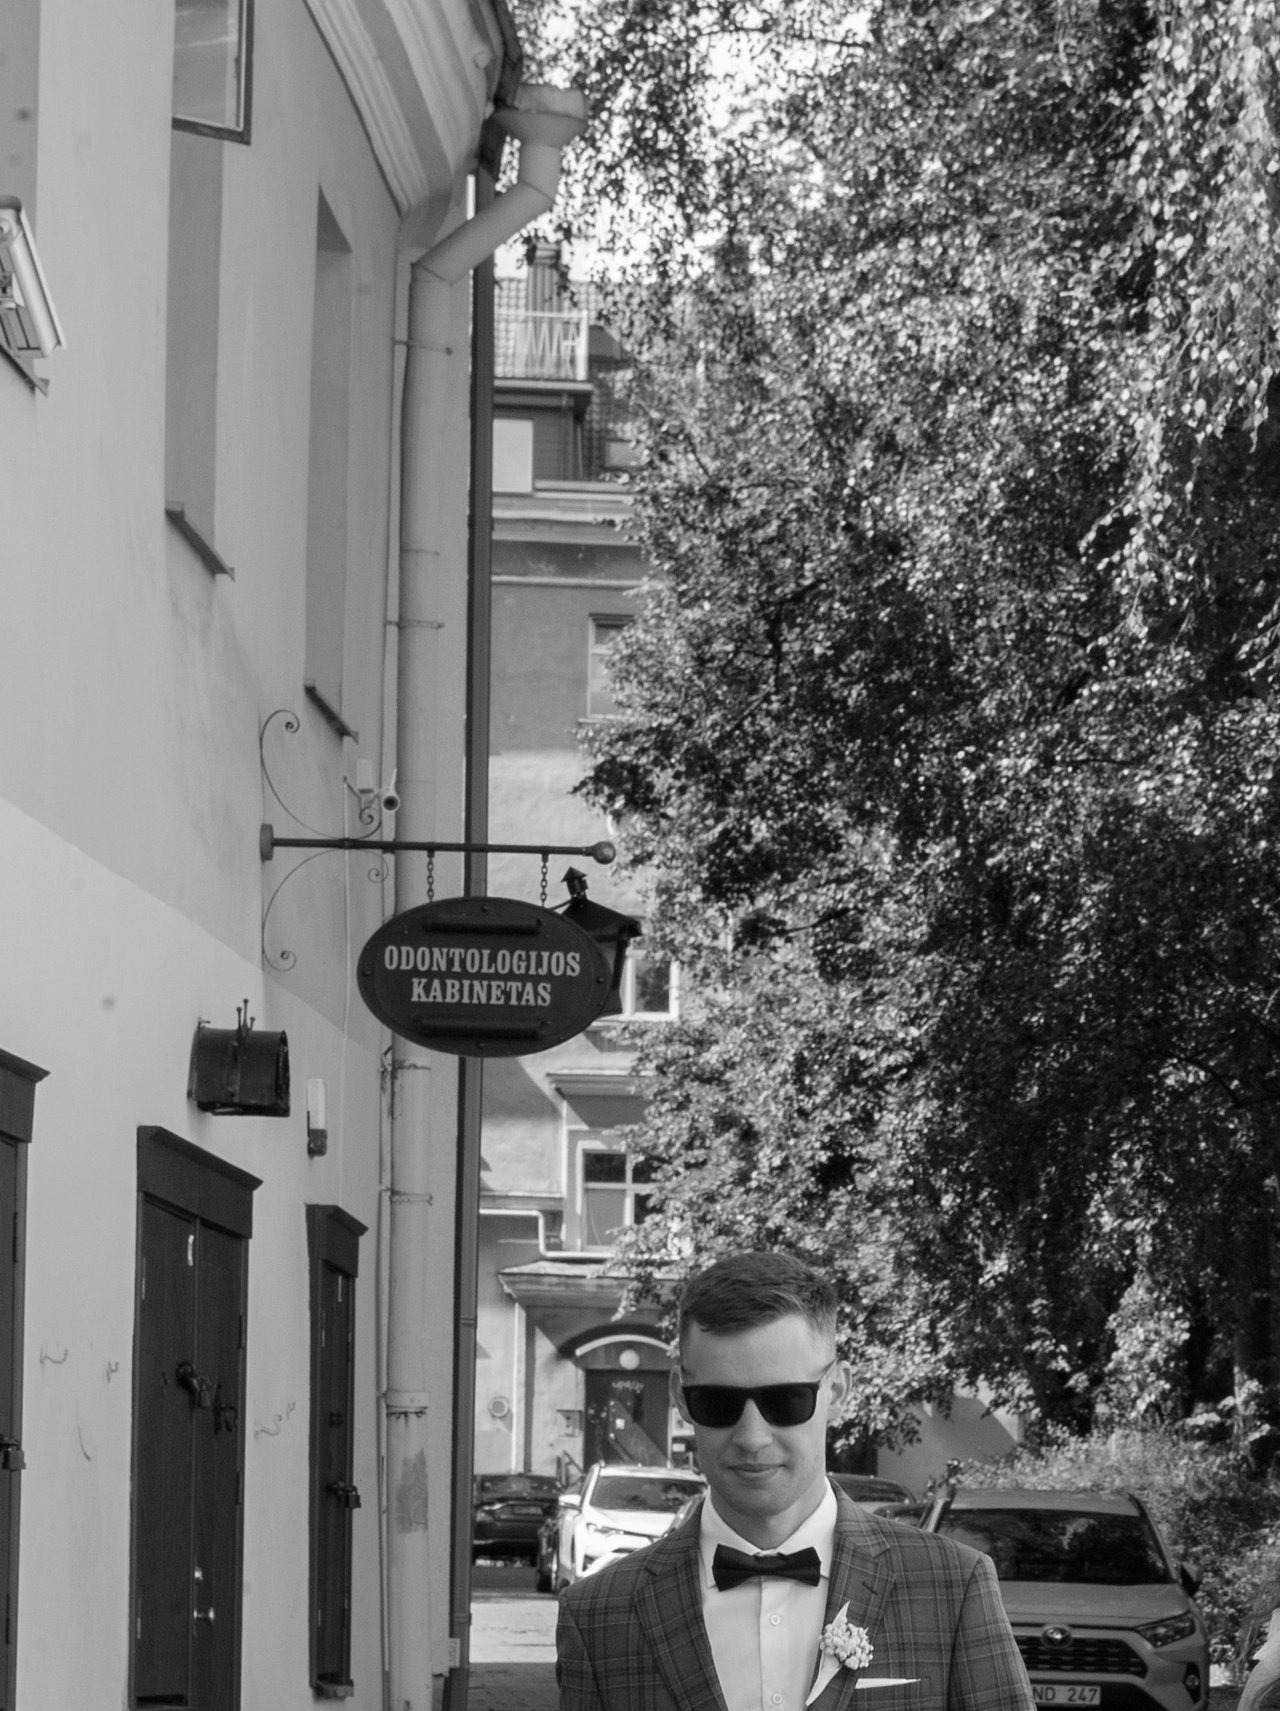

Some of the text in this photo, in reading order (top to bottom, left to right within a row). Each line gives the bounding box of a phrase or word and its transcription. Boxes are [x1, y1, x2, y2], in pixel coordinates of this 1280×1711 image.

[384, 945, 581, 977] ODONTOLOGIJOS
[411, 977, 552, 1007] KABINETAS
[1067, 1687, 1098, 1703] 247
